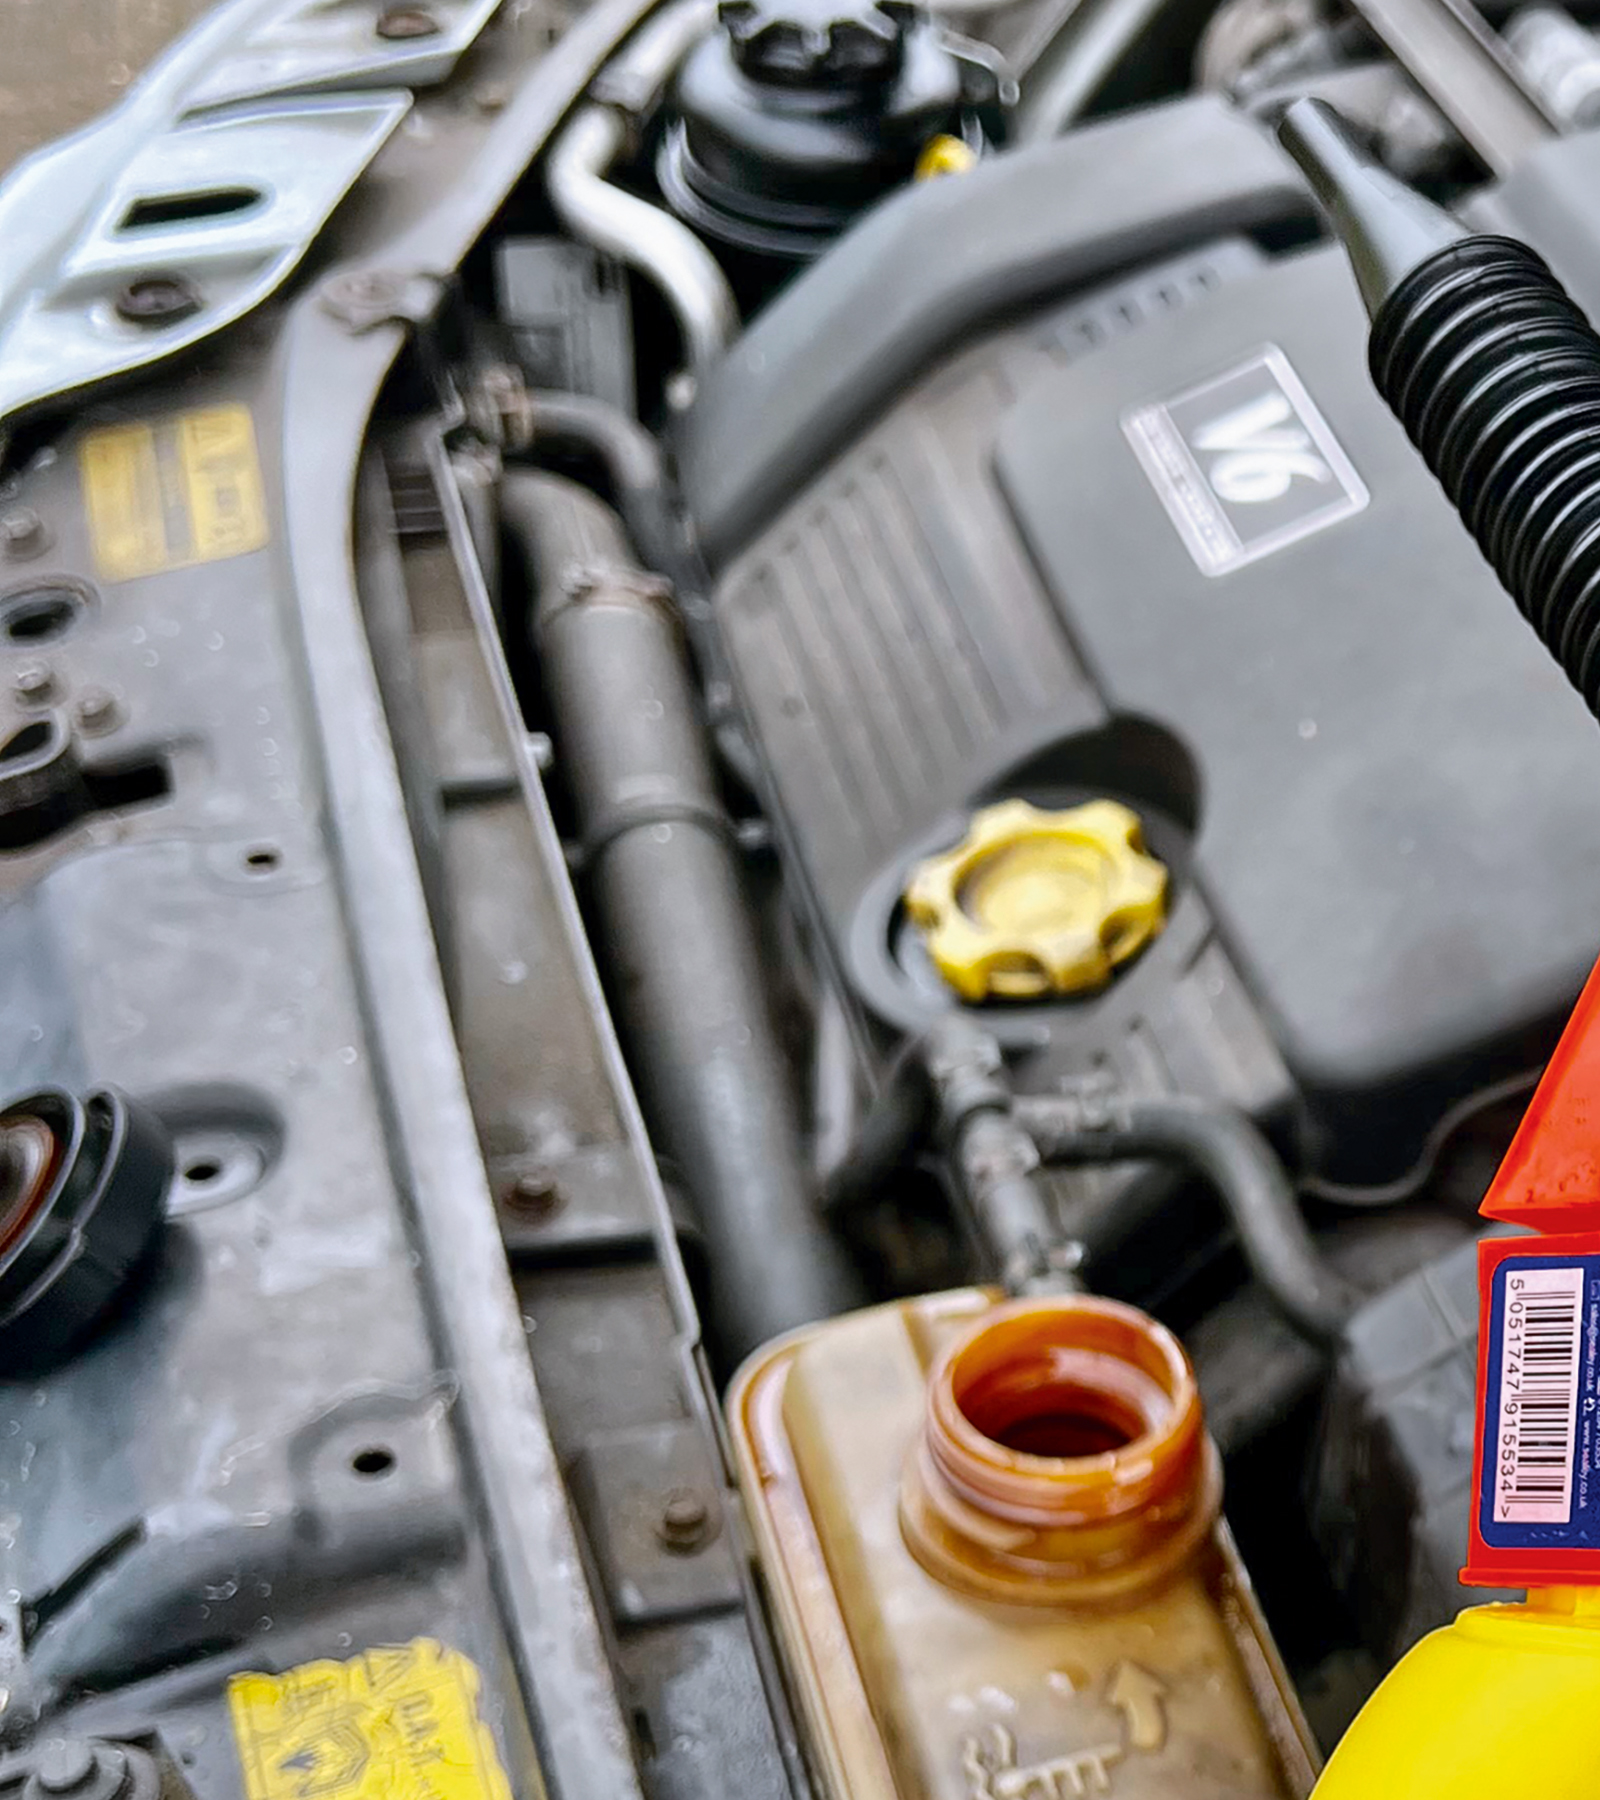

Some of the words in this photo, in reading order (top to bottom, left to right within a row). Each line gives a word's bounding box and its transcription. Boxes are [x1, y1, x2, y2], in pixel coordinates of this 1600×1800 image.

[1190, 390, 1332, 503] V6
[1506, 1302, 1524, 1390] 051747
[1500, 1402, 1519, 1492] 915534
